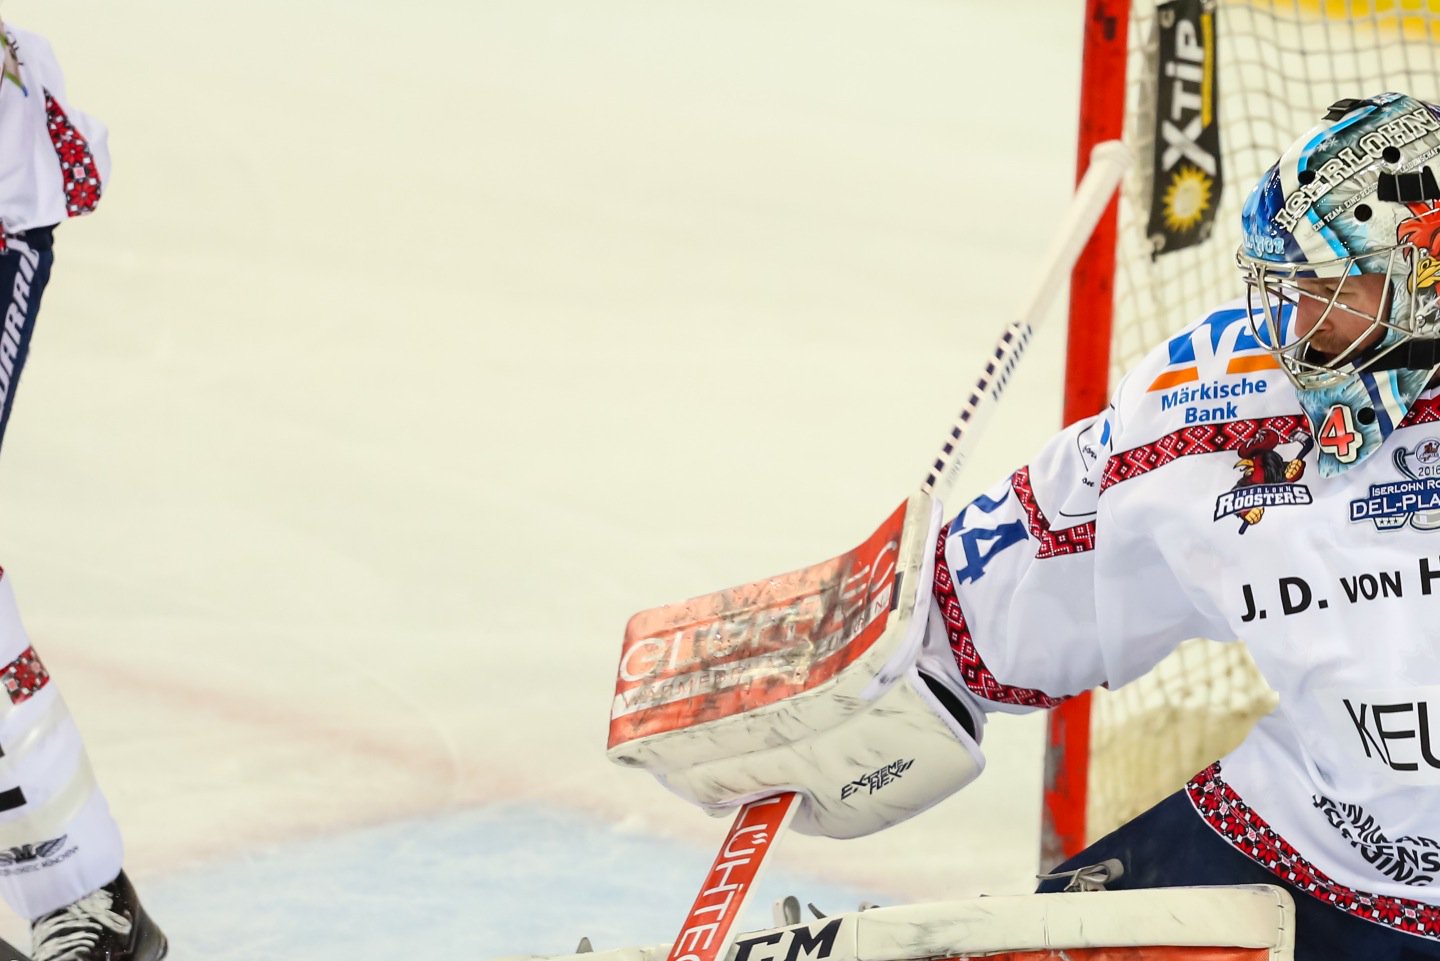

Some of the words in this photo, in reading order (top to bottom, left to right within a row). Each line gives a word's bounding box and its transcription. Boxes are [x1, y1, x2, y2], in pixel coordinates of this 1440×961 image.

[1276, 108, 1440, 232] ISERLOHN
[1161, 377, 1267, 412] Märkische
[1184, 402, 1238, 425] Bank
[1319, 405, 1359, 460] 4
[1216, 486, 1312, 519] ROOSTERS
[1372, 481, 1424, 497] ISERLOHN
[1240, 583, 1267, 622] J.
[1278, 576, 1329, 616] D.
[840, 759, 904, 800] EXTREME
